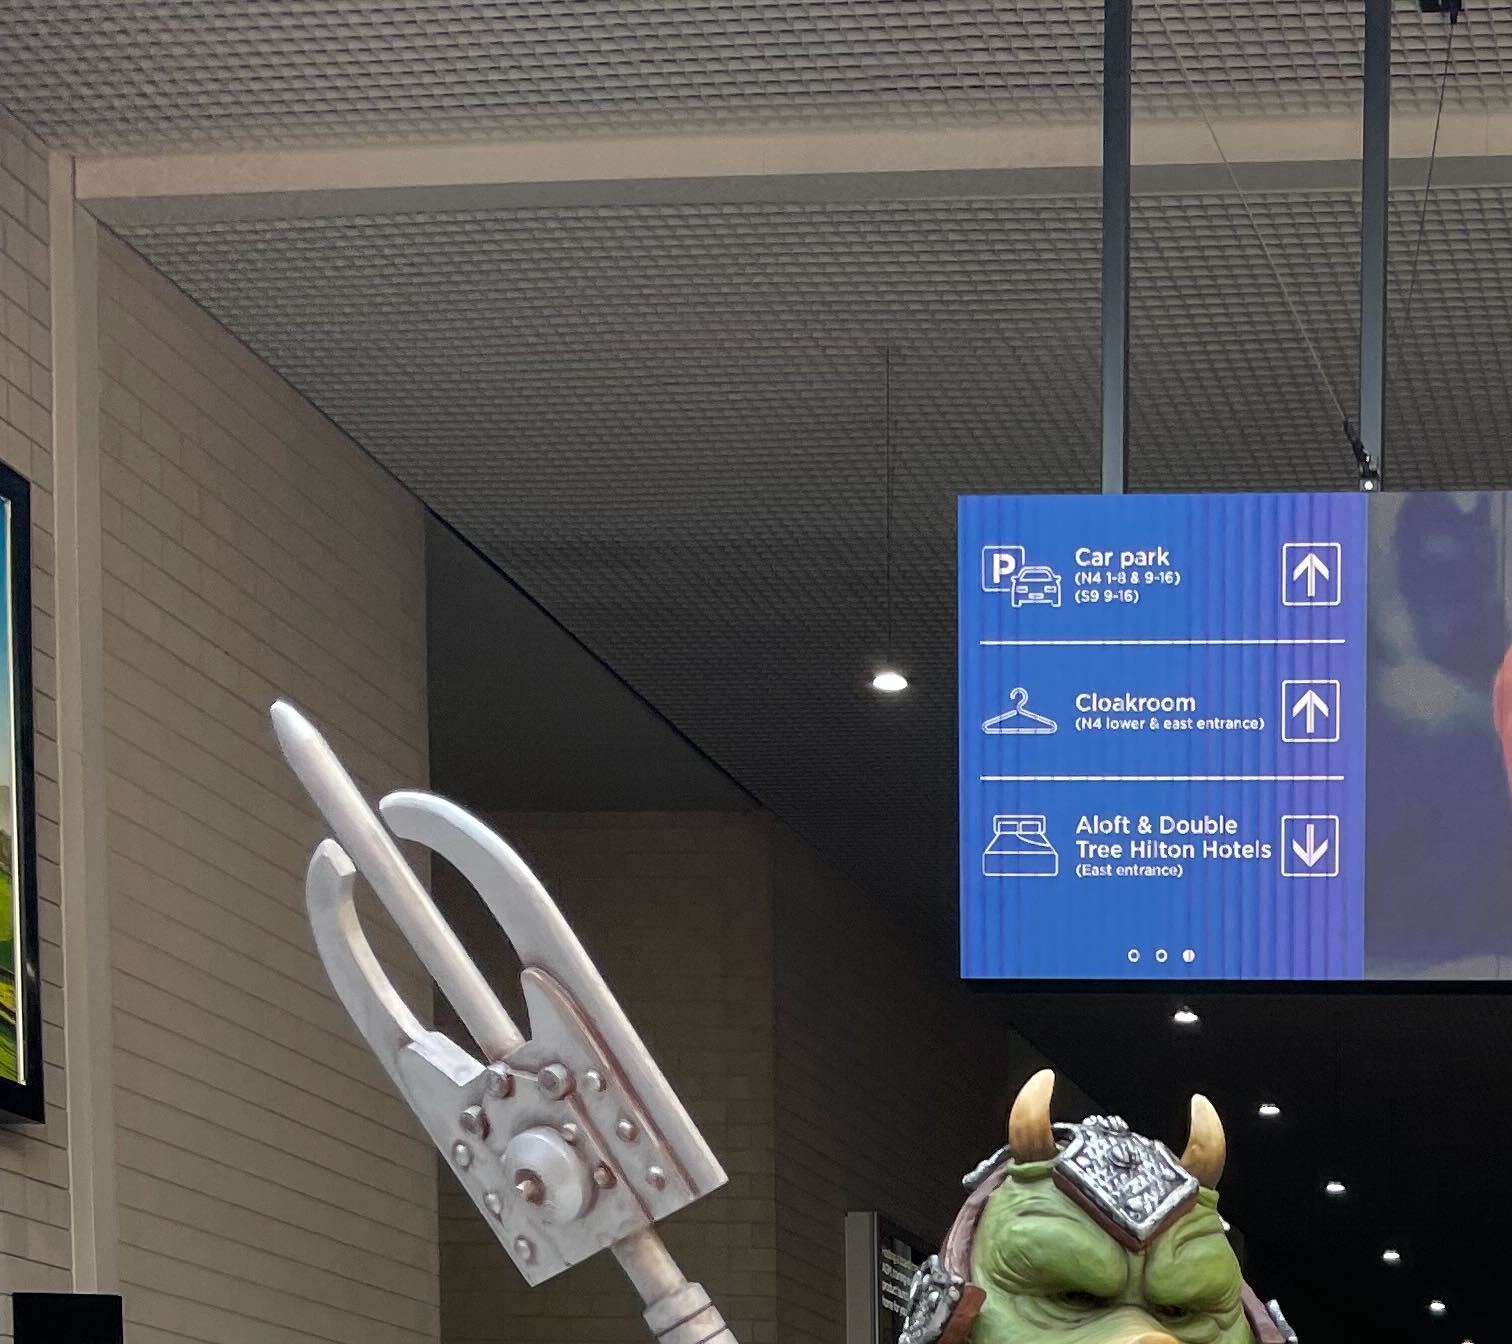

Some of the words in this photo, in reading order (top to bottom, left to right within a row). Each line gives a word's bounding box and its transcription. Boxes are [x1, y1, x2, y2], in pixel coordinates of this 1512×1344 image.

[1075, 547, 1115, 567] Car
[1120, 547, 1170, 571] park
[1074, 571, 1102, 586] (N4
[1130, 573, 1140, 585] &
[1144, 571, 1181, 586] 9-16)
[1074, 589, 1099, 604] (S9
[1104, 589, 1140, 604] 9-16)
[1075, 693, 1197, 714] Cloakroom
[1075, 716, 1103, 732] (N4
[1106, 716, 1146, 731] lower
[1149, 717, 1160, 730] &
[1163, 718, 1193, 731] east
[1196, 716, 1265, 732] entrance)
[1076, 814, 1131, 834] Aloft
[1137, 815, 1153, 834] &
[1159, 815, 1238, 834] Double
[1075, 841, 1123, 859] Tree
[1130, 840, 1195, 859] Hilton
[1202, 840, 1272, 859] Hotels
[1075, 863, 1113, 879] (East
[1115, 864, 1184, 879] entrance)
